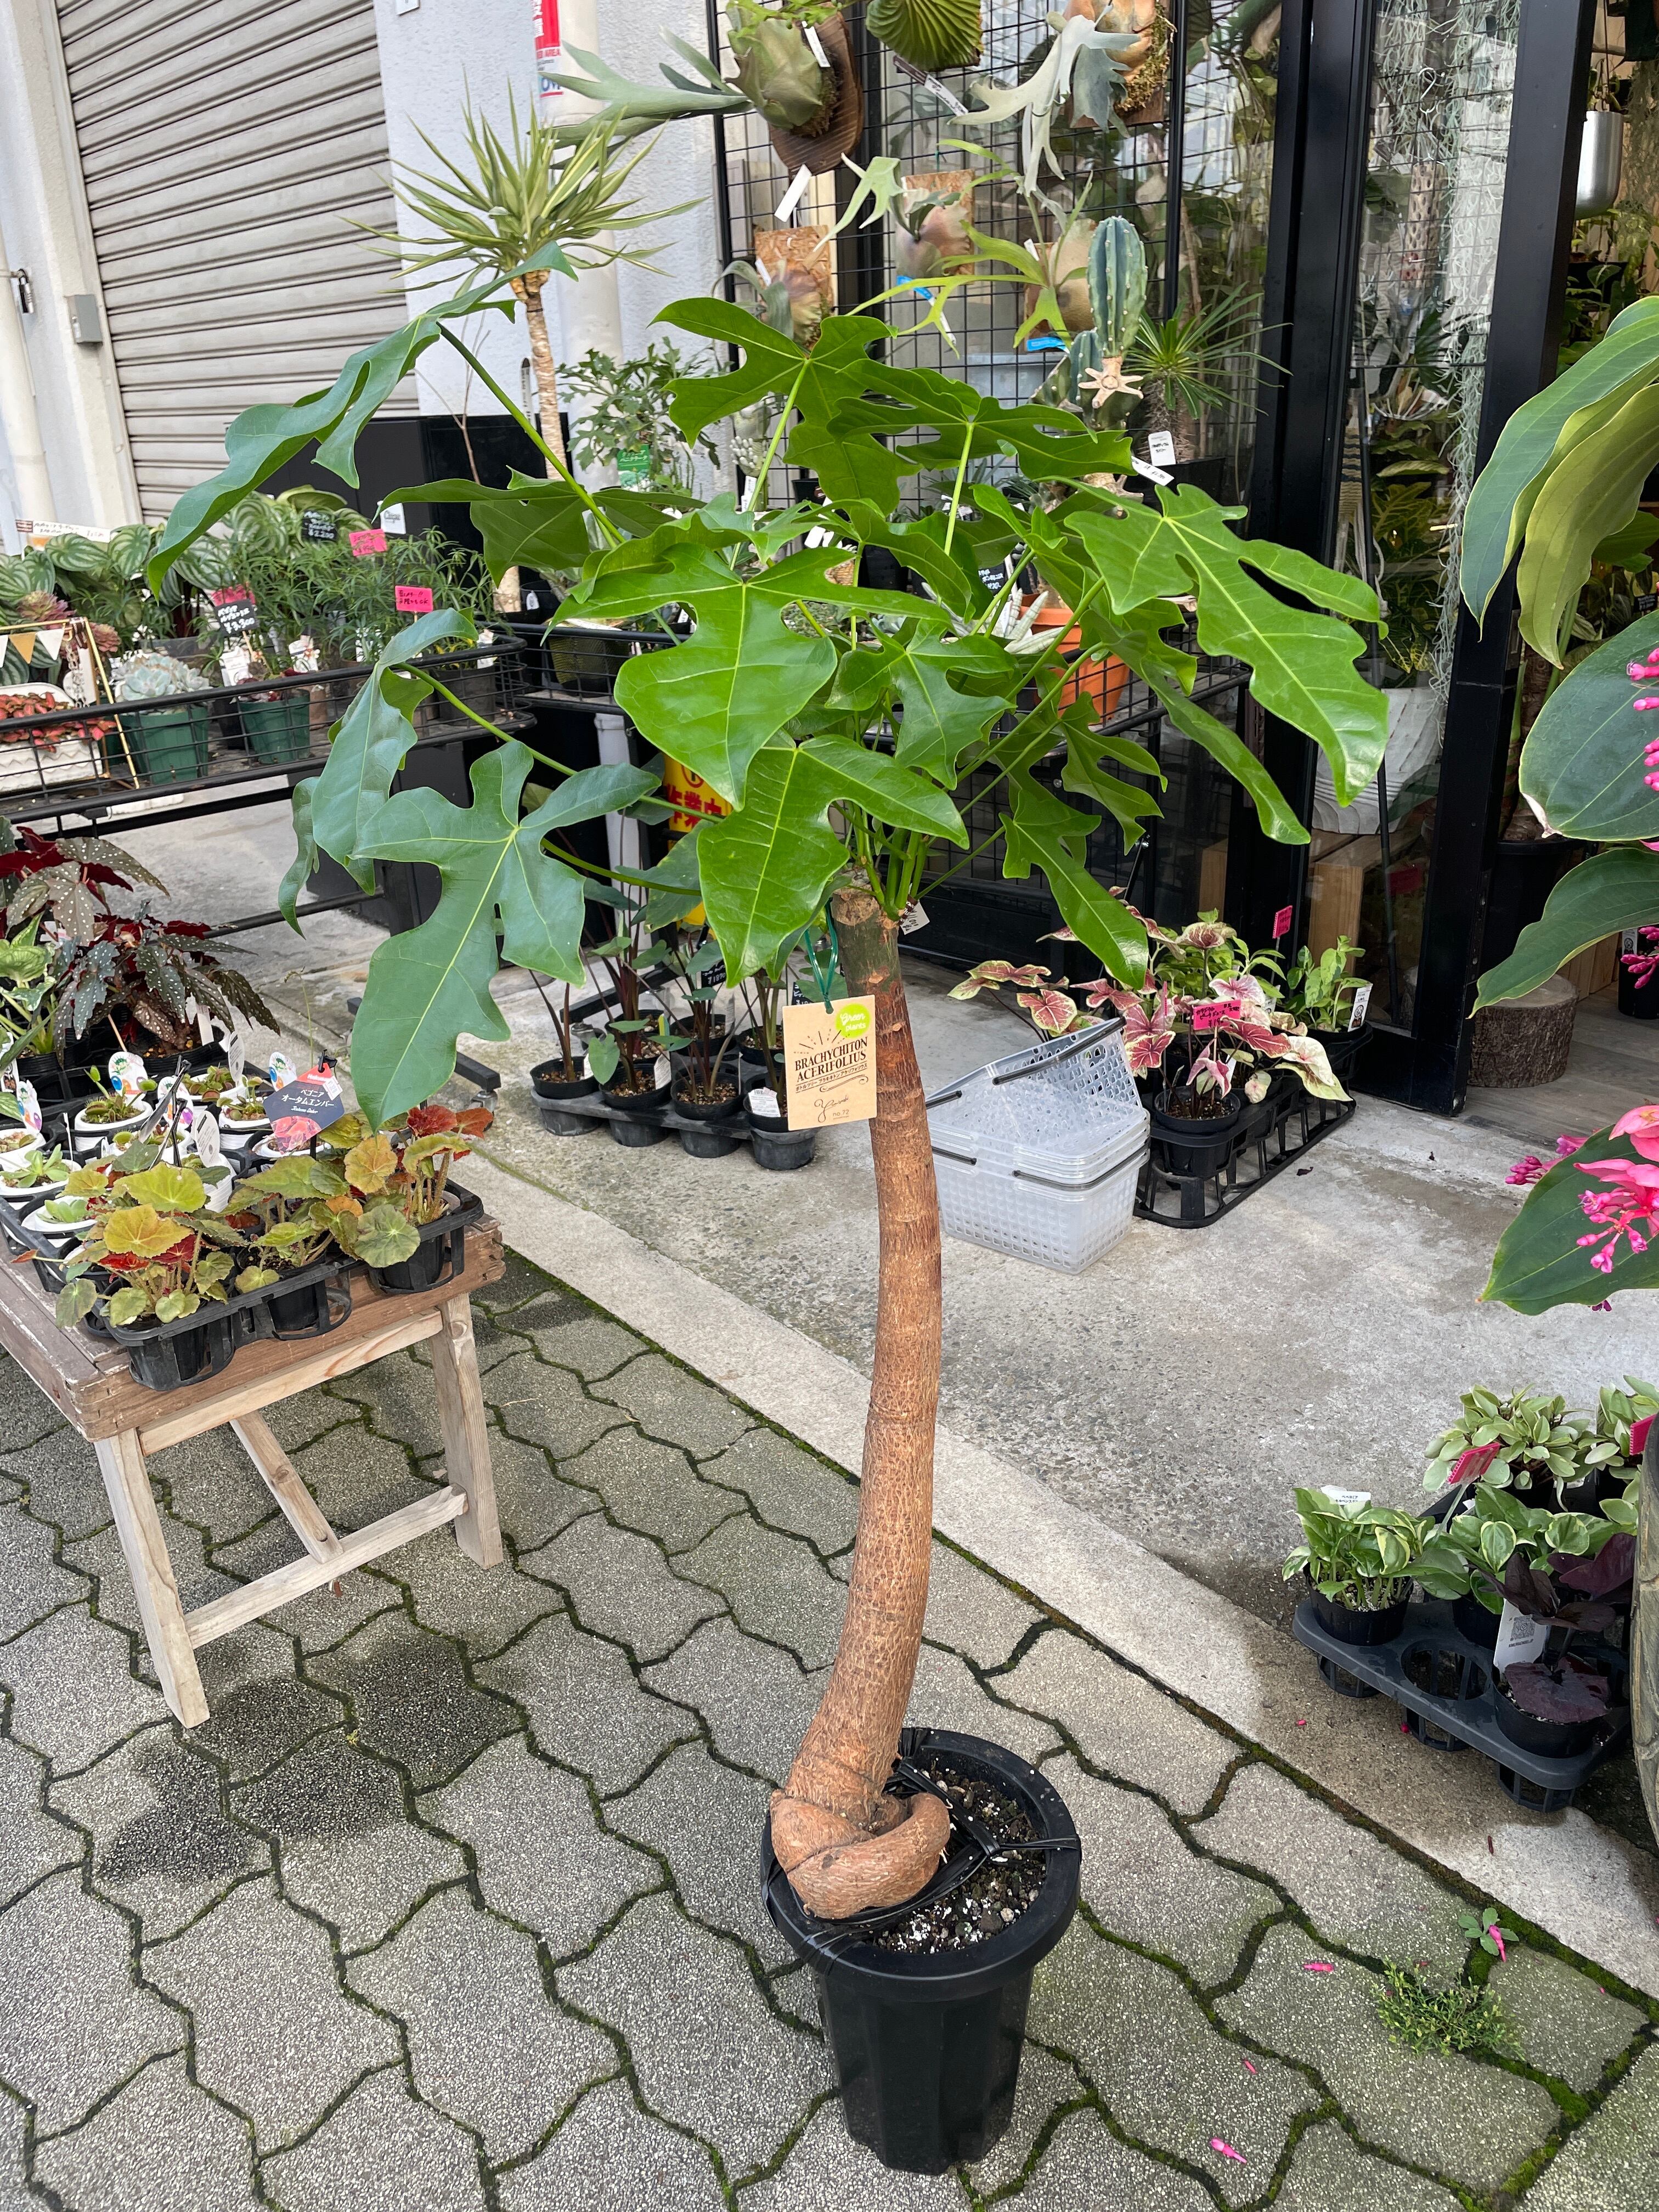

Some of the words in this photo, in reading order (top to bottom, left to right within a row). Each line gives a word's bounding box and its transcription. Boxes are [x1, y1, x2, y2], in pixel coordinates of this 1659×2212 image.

[840, 1013, 865, 1025] Green
[845, 1023, 867, 1032] plants
[794, 1036, 868, 1071] BRACHYCHITON
[797, 1050, 866, 1083] ACERIFOLIUS
[281, 1093, 335, 1107] オータムエンバー
